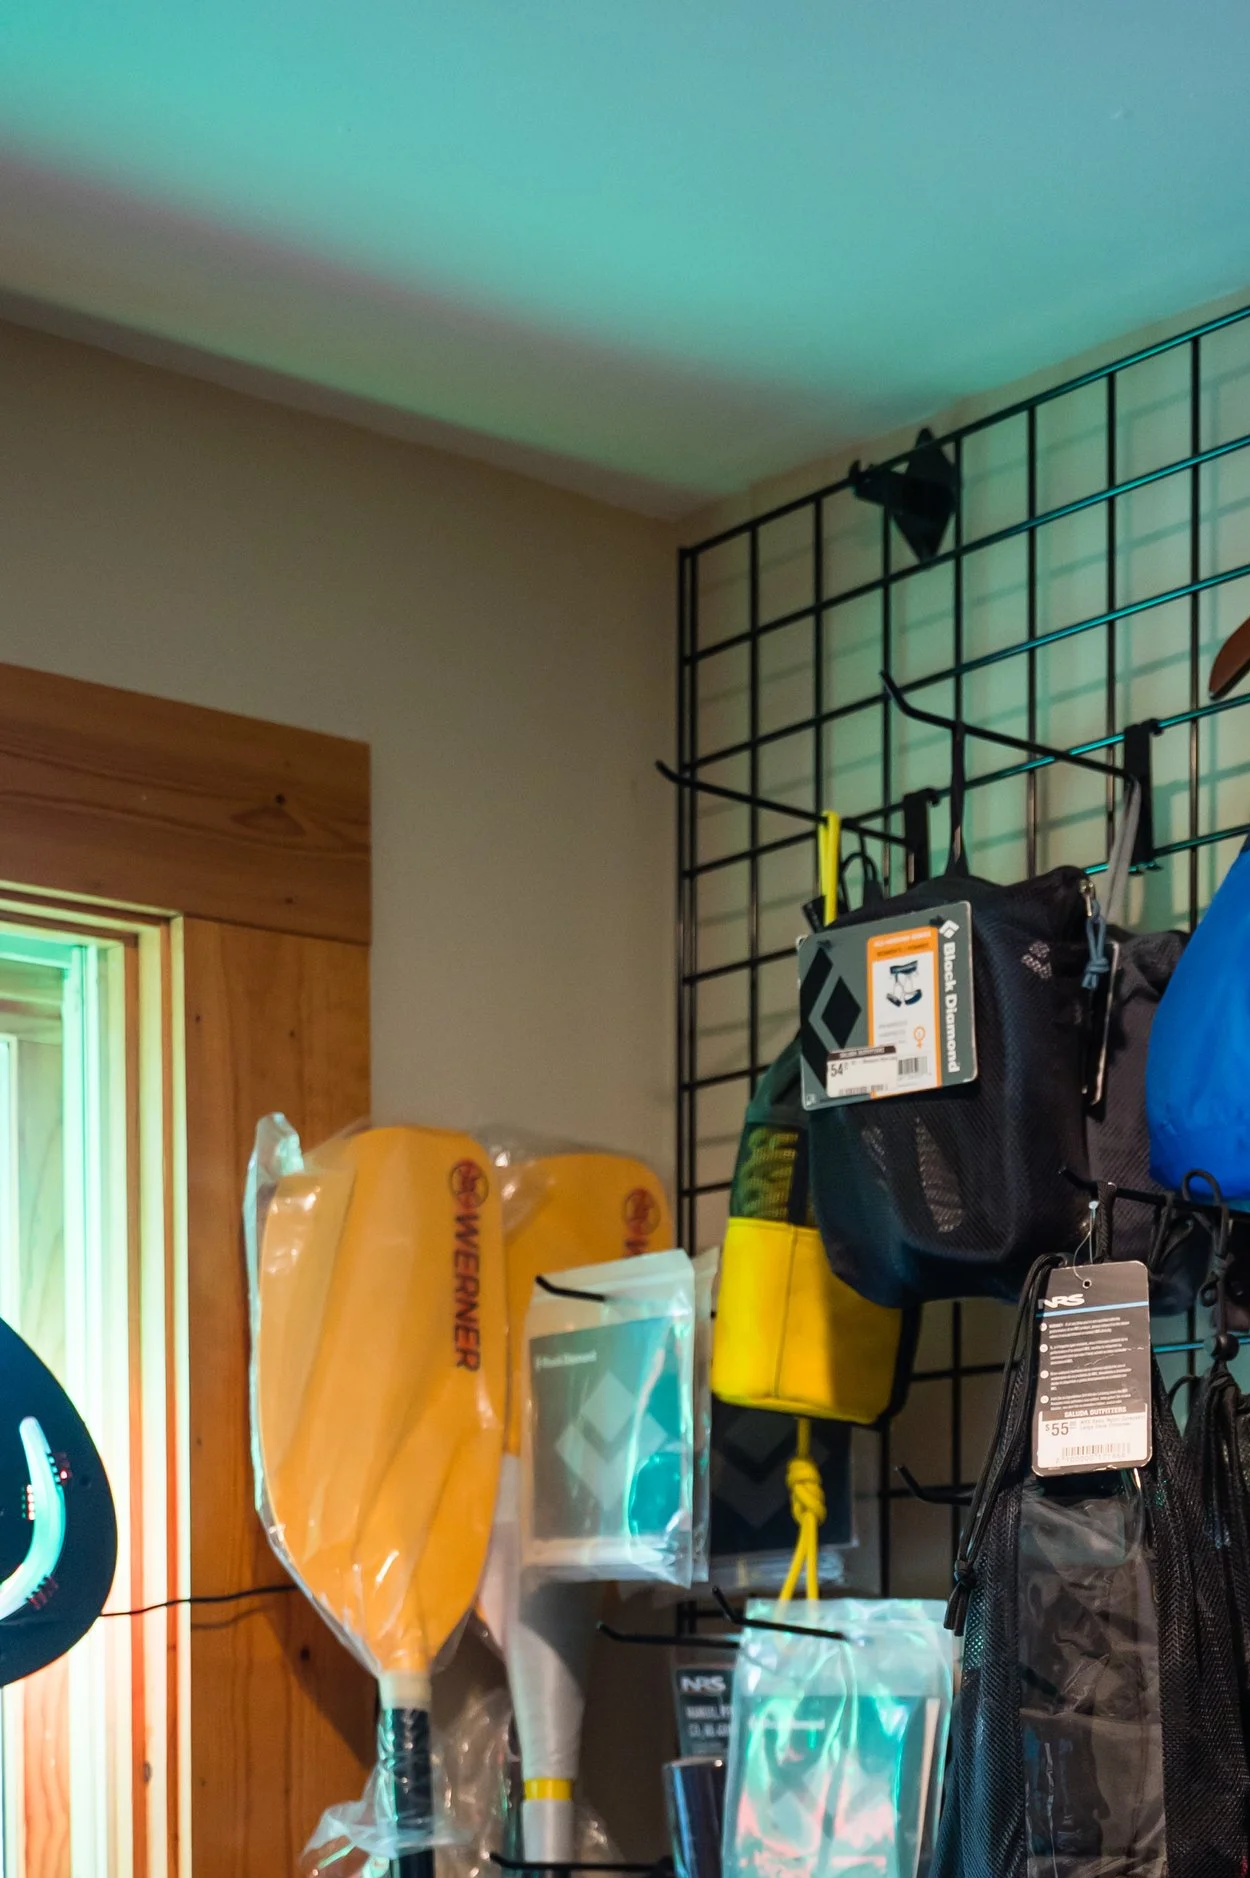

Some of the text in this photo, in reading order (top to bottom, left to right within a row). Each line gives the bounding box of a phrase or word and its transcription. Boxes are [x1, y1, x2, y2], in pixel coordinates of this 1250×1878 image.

[943, 941, 961, 1073] Black Diamond
[454, 1214, 480, 1372] WERNER
[1038, 1293, 1085, 1309] NRS
[1064, 1406, 1127, 1418] SALUDA OUTFITTERS
[680, 1675, 726, 1693] NRS
